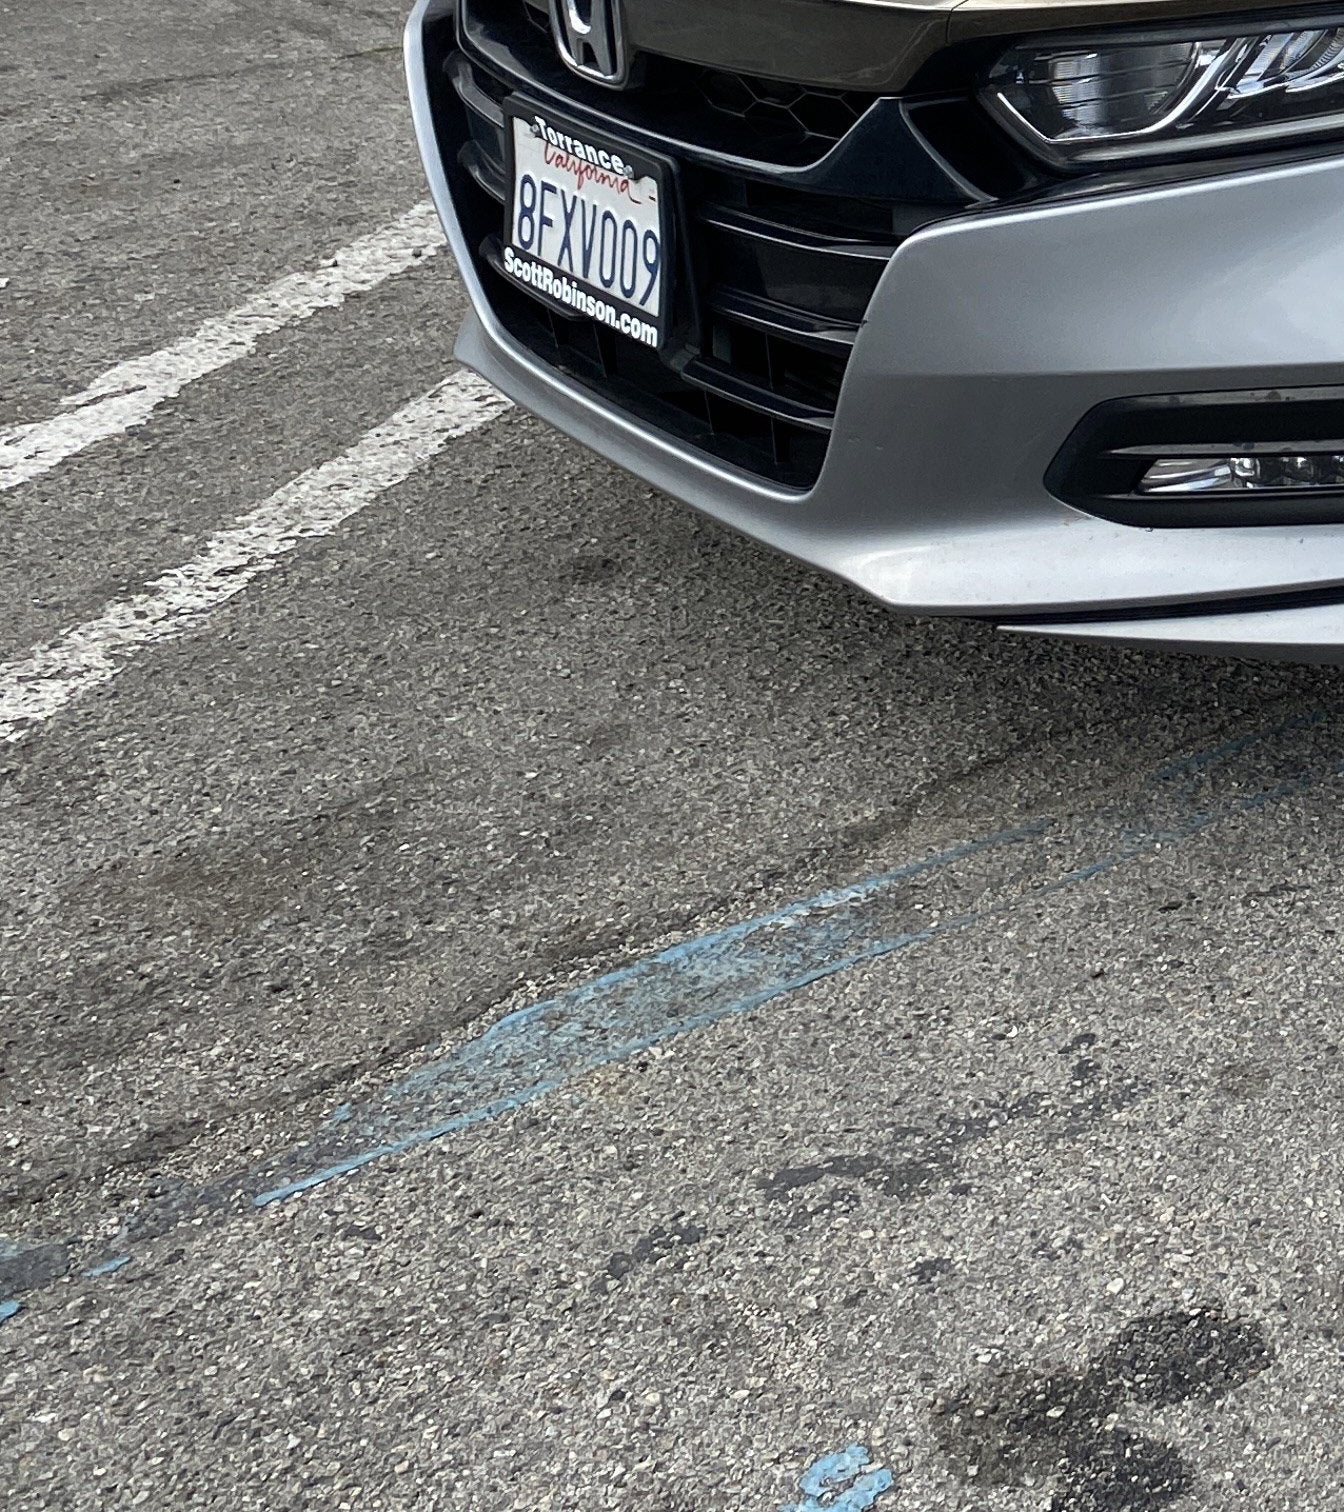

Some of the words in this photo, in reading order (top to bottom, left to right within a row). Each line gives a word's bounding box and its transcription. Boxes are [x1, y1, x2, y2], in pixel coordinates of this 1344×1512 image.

[534, 116, 626, 175] Torrance
[543, 142, 643, 205] California
[517, 174, 661, 306] 8FXV009
[504, 247, 660, 347] ScottRobinson.com
